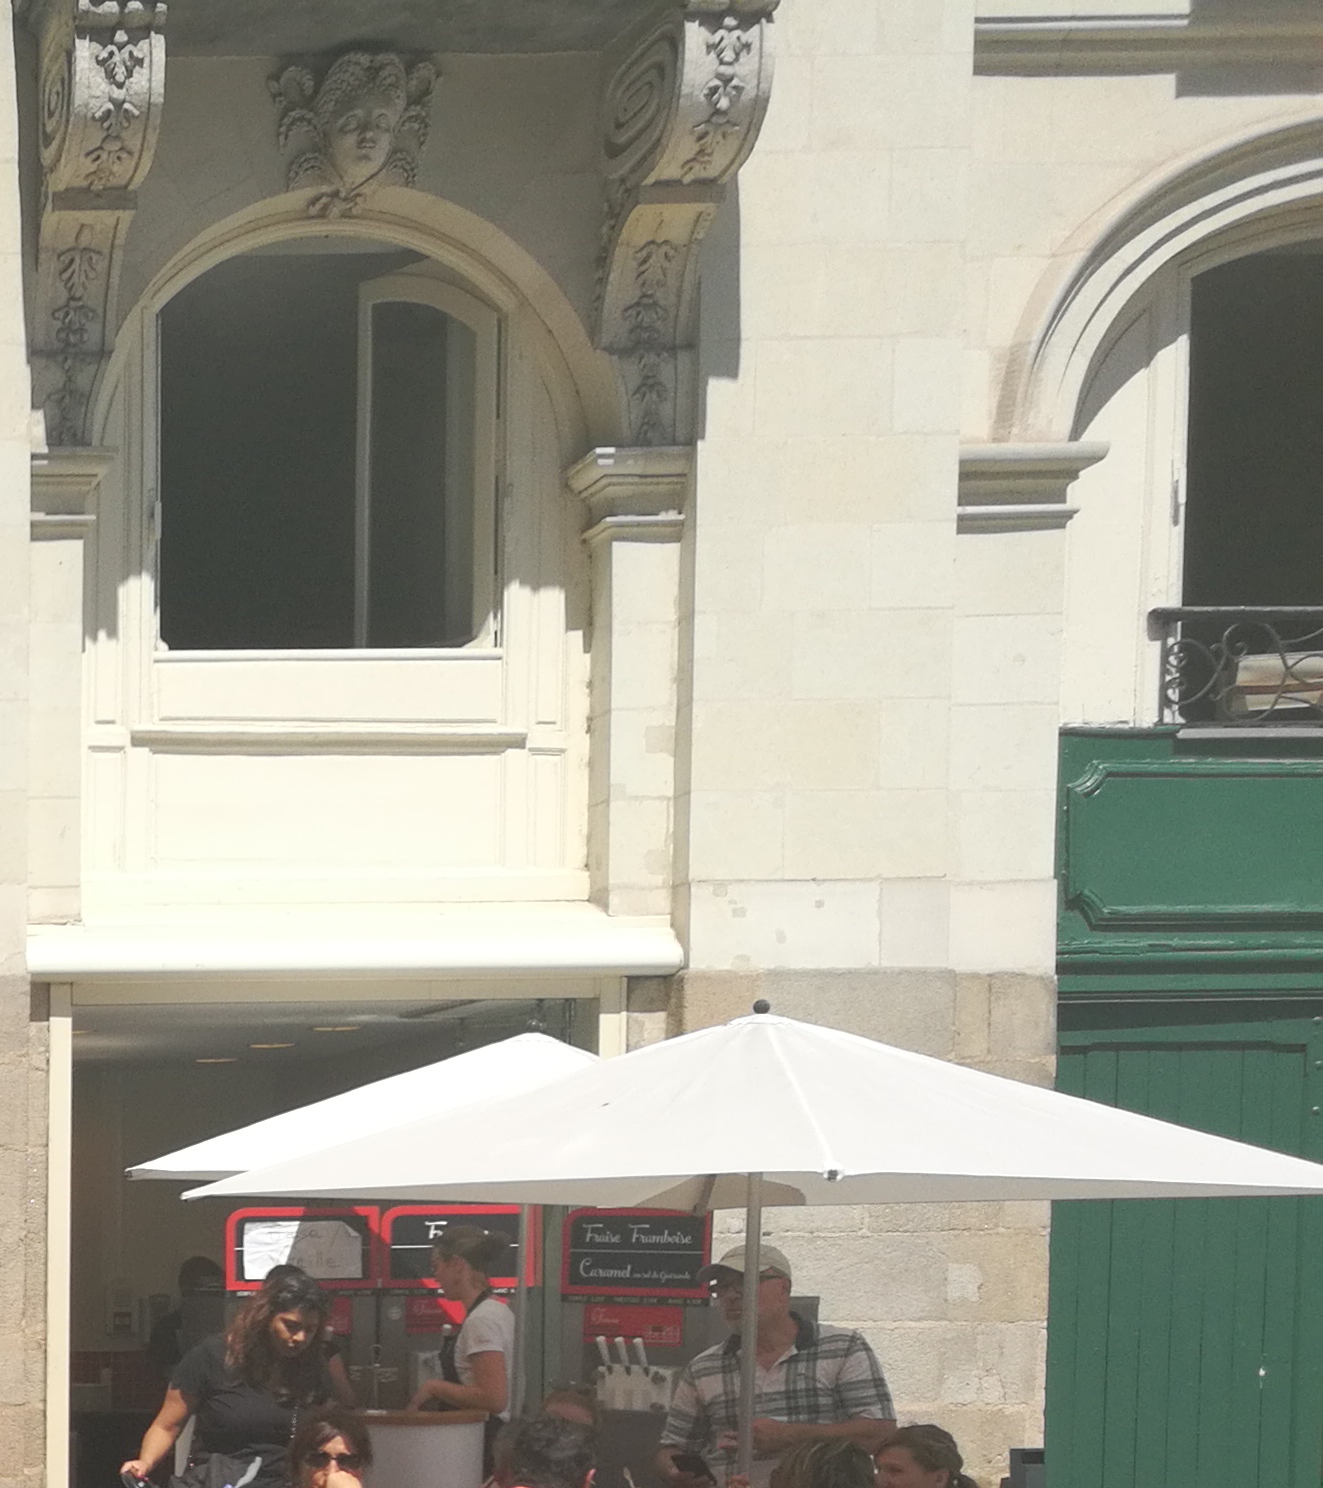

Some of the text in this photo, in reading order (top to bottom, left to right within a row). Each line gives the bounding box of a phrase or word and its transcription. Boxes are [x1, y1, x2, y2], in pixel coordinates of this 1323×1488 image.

[582, 1223, 693, 1244] Fraise Framboise
[579, 1257, 631, 1278] Caramel
